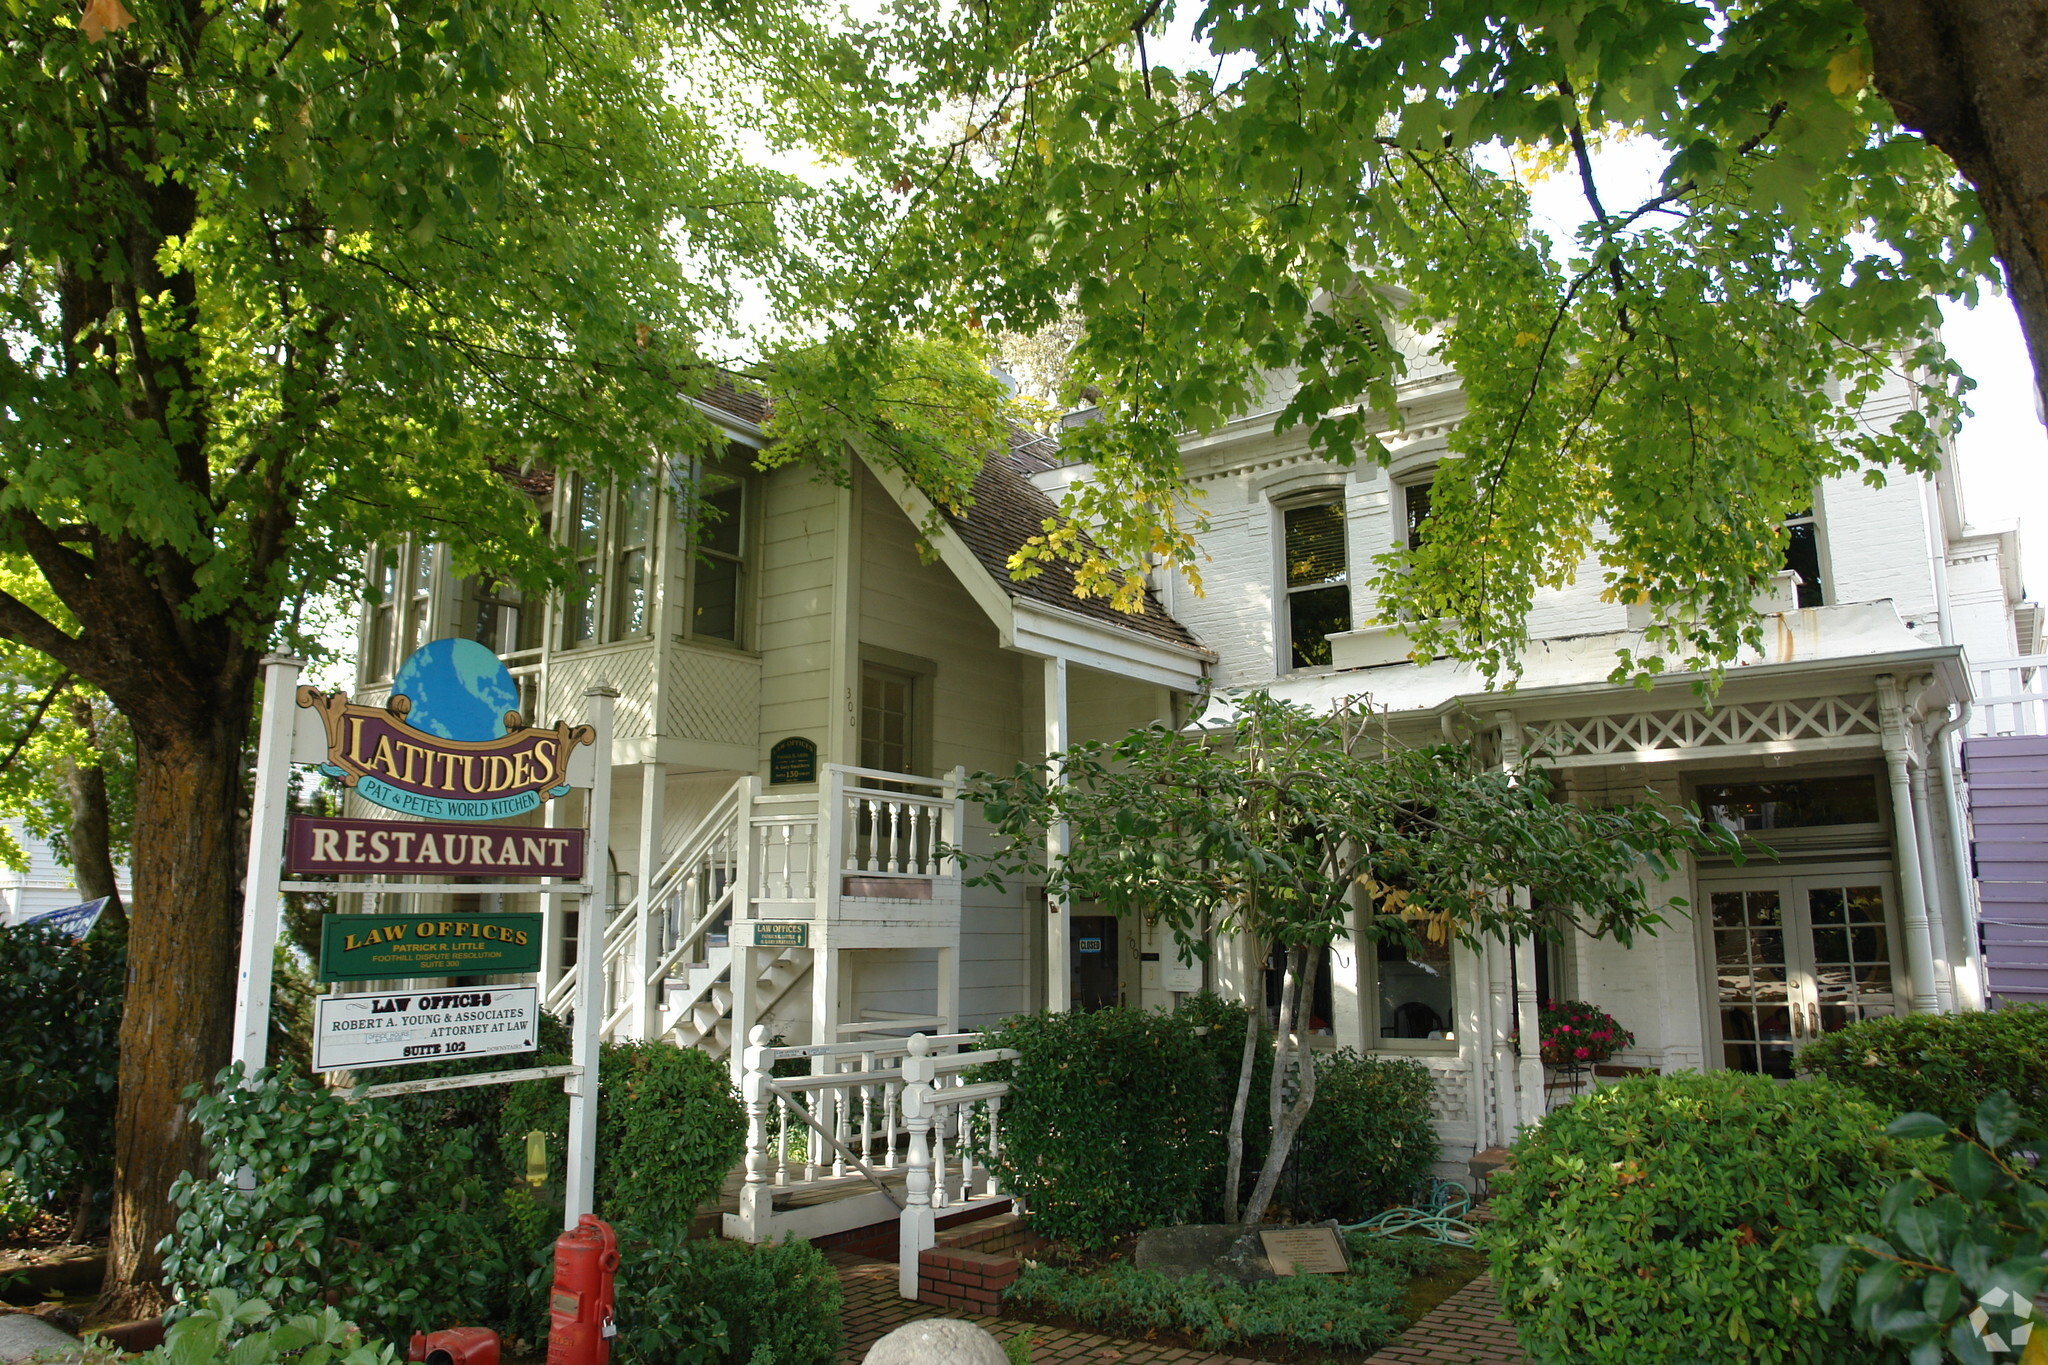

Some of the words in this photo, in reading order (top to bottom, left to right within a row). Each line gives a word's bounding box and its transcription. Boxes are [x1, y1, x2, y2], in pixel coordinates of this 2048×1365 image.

[846, 687, 856, 728] 300
[349, 717, 556, 794] LATITUDES
[364, 780, 389, 802] PAT
[392, 794, 401, 804] &
[403, 794, 444, 815] PETE'S
[448, 801, 490, 817] WORLD
[491, 792, 536, 816] KITCHEN
[311, 827, 569, 867] RESTAURANT
[344, 923, 408, 952] LAW
[416, 920, 529, 946] OFFICES
[757, 924, 771, 933] LAW
[772, 924, 802, 933] OFFICES
[392, 943, 438, 952] PATRICK
[439, 943, 450, 951] R.
[452, 942, 486, 951] LITTLE
[1080, 940, 1100, 950] CLOSED
[372, 953, 414, 962] FOOTHILL
[415, 953, 451, 961] DISPUTE
[452, 951, 502, 960] RESOLUTION
[420, 961, 444, 969] SUITE
[446, 960, 460, 968] 300
[371, 998, 412, 1014] LAW
[418, 993, 493, 1011] OFFICES
[332, 1018, 384, 1031] ROBERT
[385, 1017, 398, 1028] A.
[402, 1014, 441, 1027] YOUNG
[443, 1013, 452, 1022] &
[454, 1008, 525, 1022] ASSOCIATES
[430, 1024, 489, 1038] ATTORNEY
[490, 1022, 504, 1032] AT
[506, 1020, 529, 1032] LAW
[403, 1043, 442, 1057] SUITE
[444, 1041, 467, 1054] 102
[486, 1043, 523, 1053] DOWNSTAIRS
